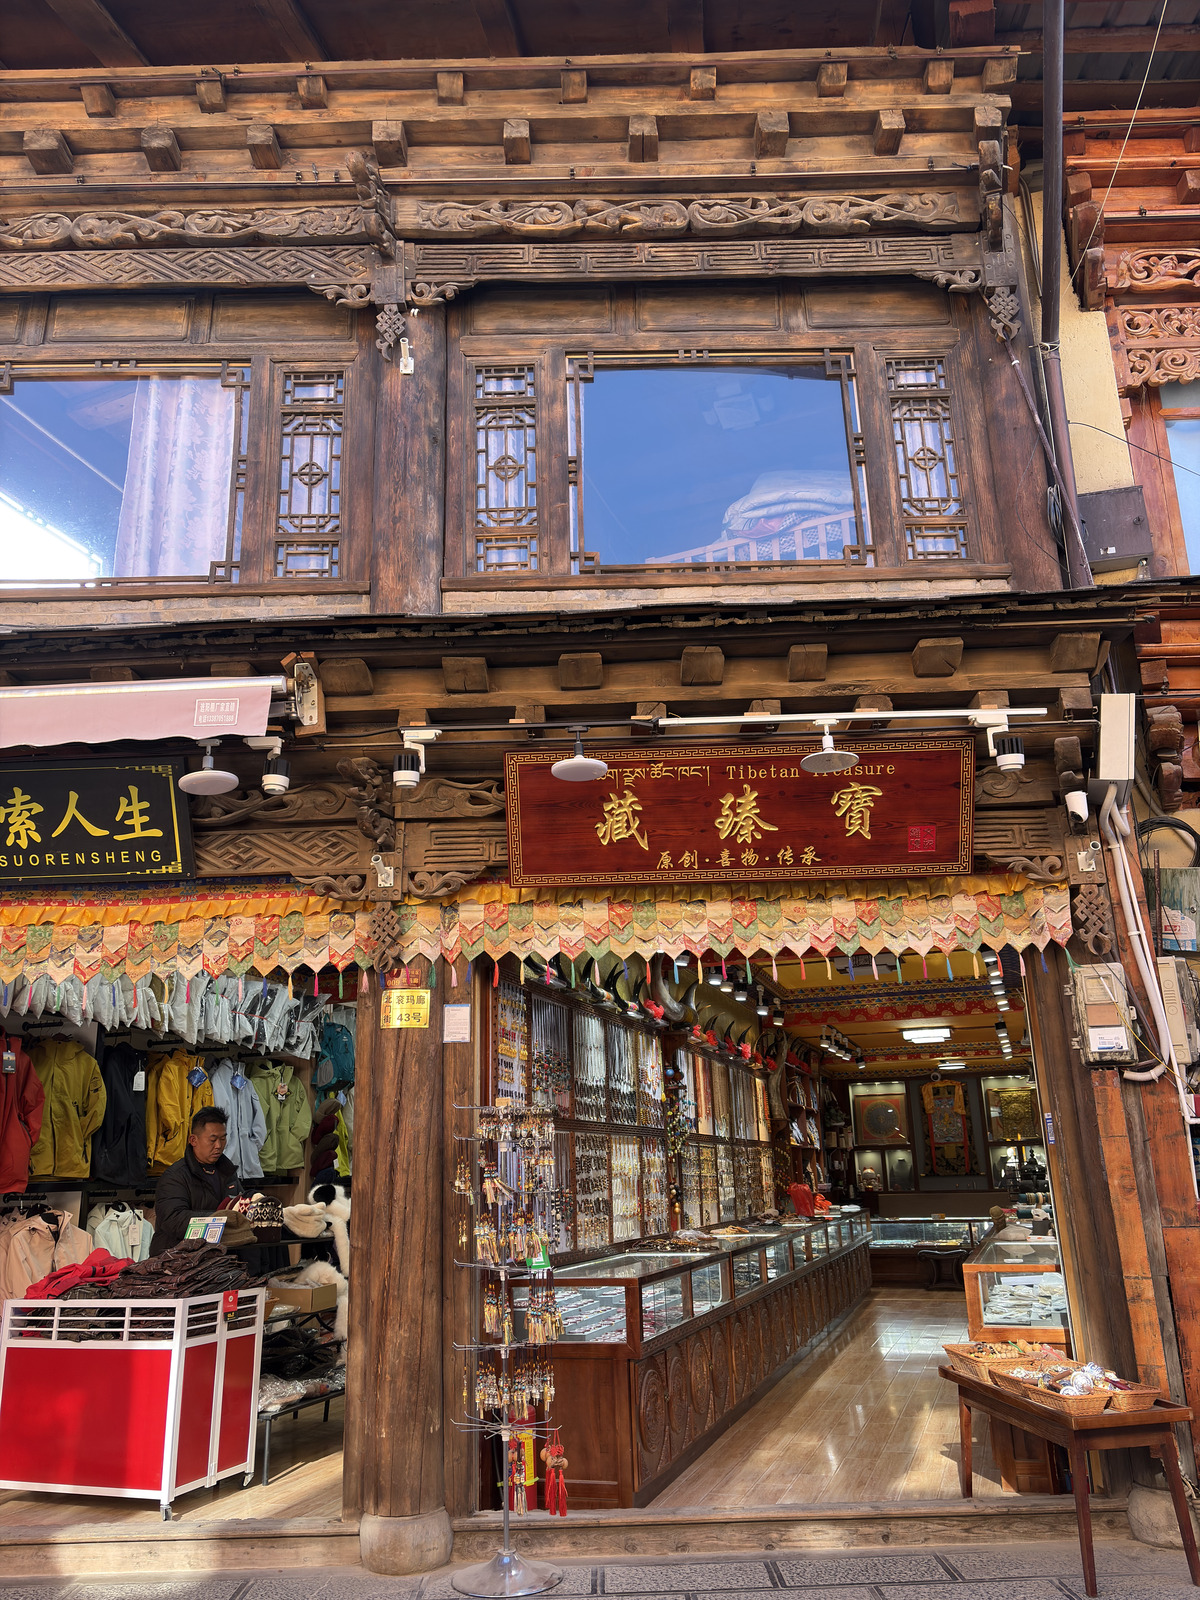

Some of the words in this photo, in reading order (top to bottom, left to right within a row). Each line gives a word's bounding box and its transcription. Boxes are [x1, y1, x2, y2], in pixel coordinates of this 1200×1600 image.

[726, 765, 800, 780] Tibetan
[813, 763, 896, 778] easure
[0, 850, 162, 867] SUORENSHENG
[397, 1013, 422, 1023] 43号
